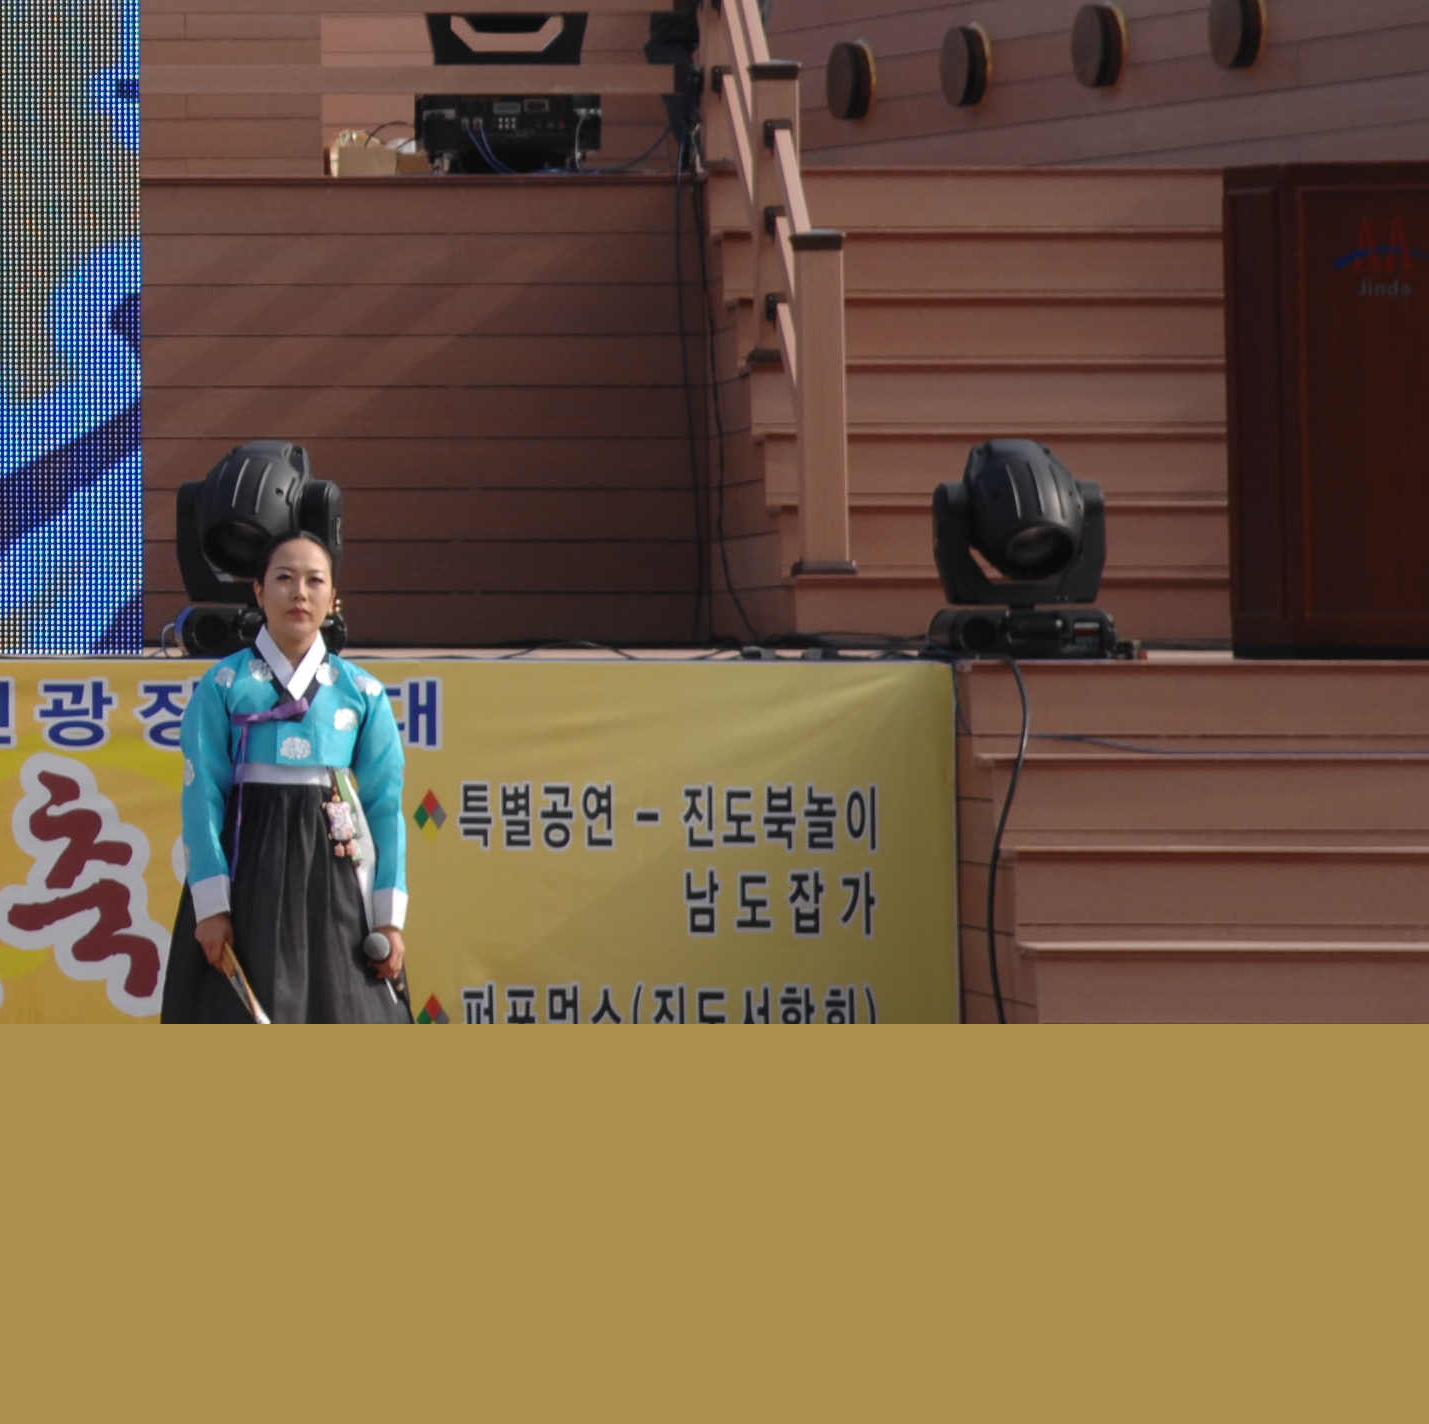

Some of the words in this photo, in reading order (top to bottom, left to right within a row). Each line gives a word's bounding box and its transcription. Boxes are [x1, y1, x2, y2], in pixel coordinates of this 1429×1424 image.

[458, 783, 614, 849] 특별공연
[636, 810, 659, 823] -
[683, 784, 877, 851] 진도북놀이
